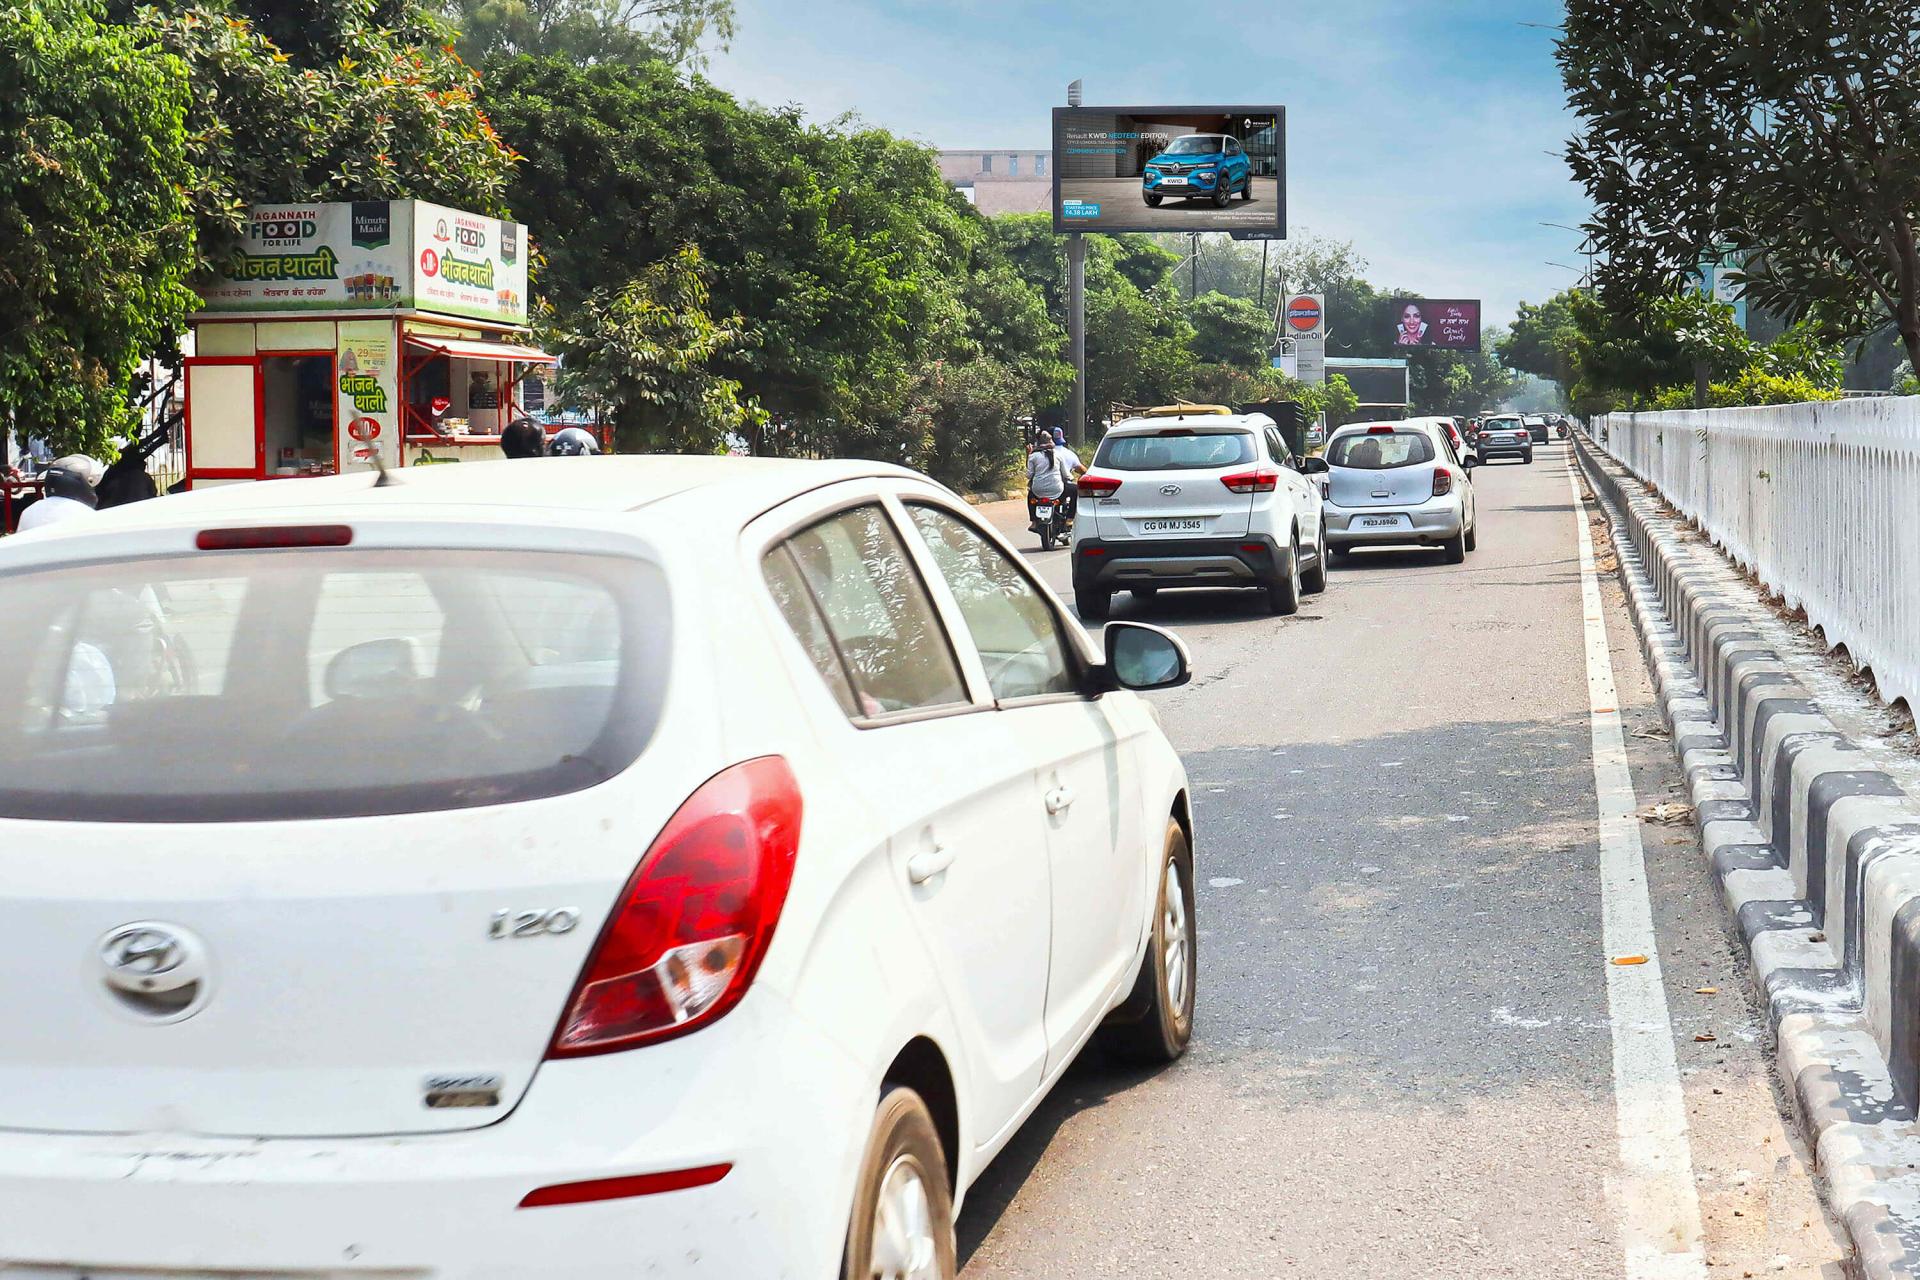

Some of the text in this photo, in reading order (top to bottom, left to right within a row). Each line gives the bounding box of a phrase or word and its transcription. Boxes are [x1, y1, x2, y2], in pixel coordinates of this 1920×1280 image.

[355, 216, 388, 225] Minute
[251, 220, 317, 239] FOOD
[360, 224, 383, 233] Maid
[456, 226, 486, 248] FOOD
[283, 239, 302, 247] LIFE
[1144, 521, 1201, 530] CG 04 MJ 3545
[489, 906, 581, 939] i20
